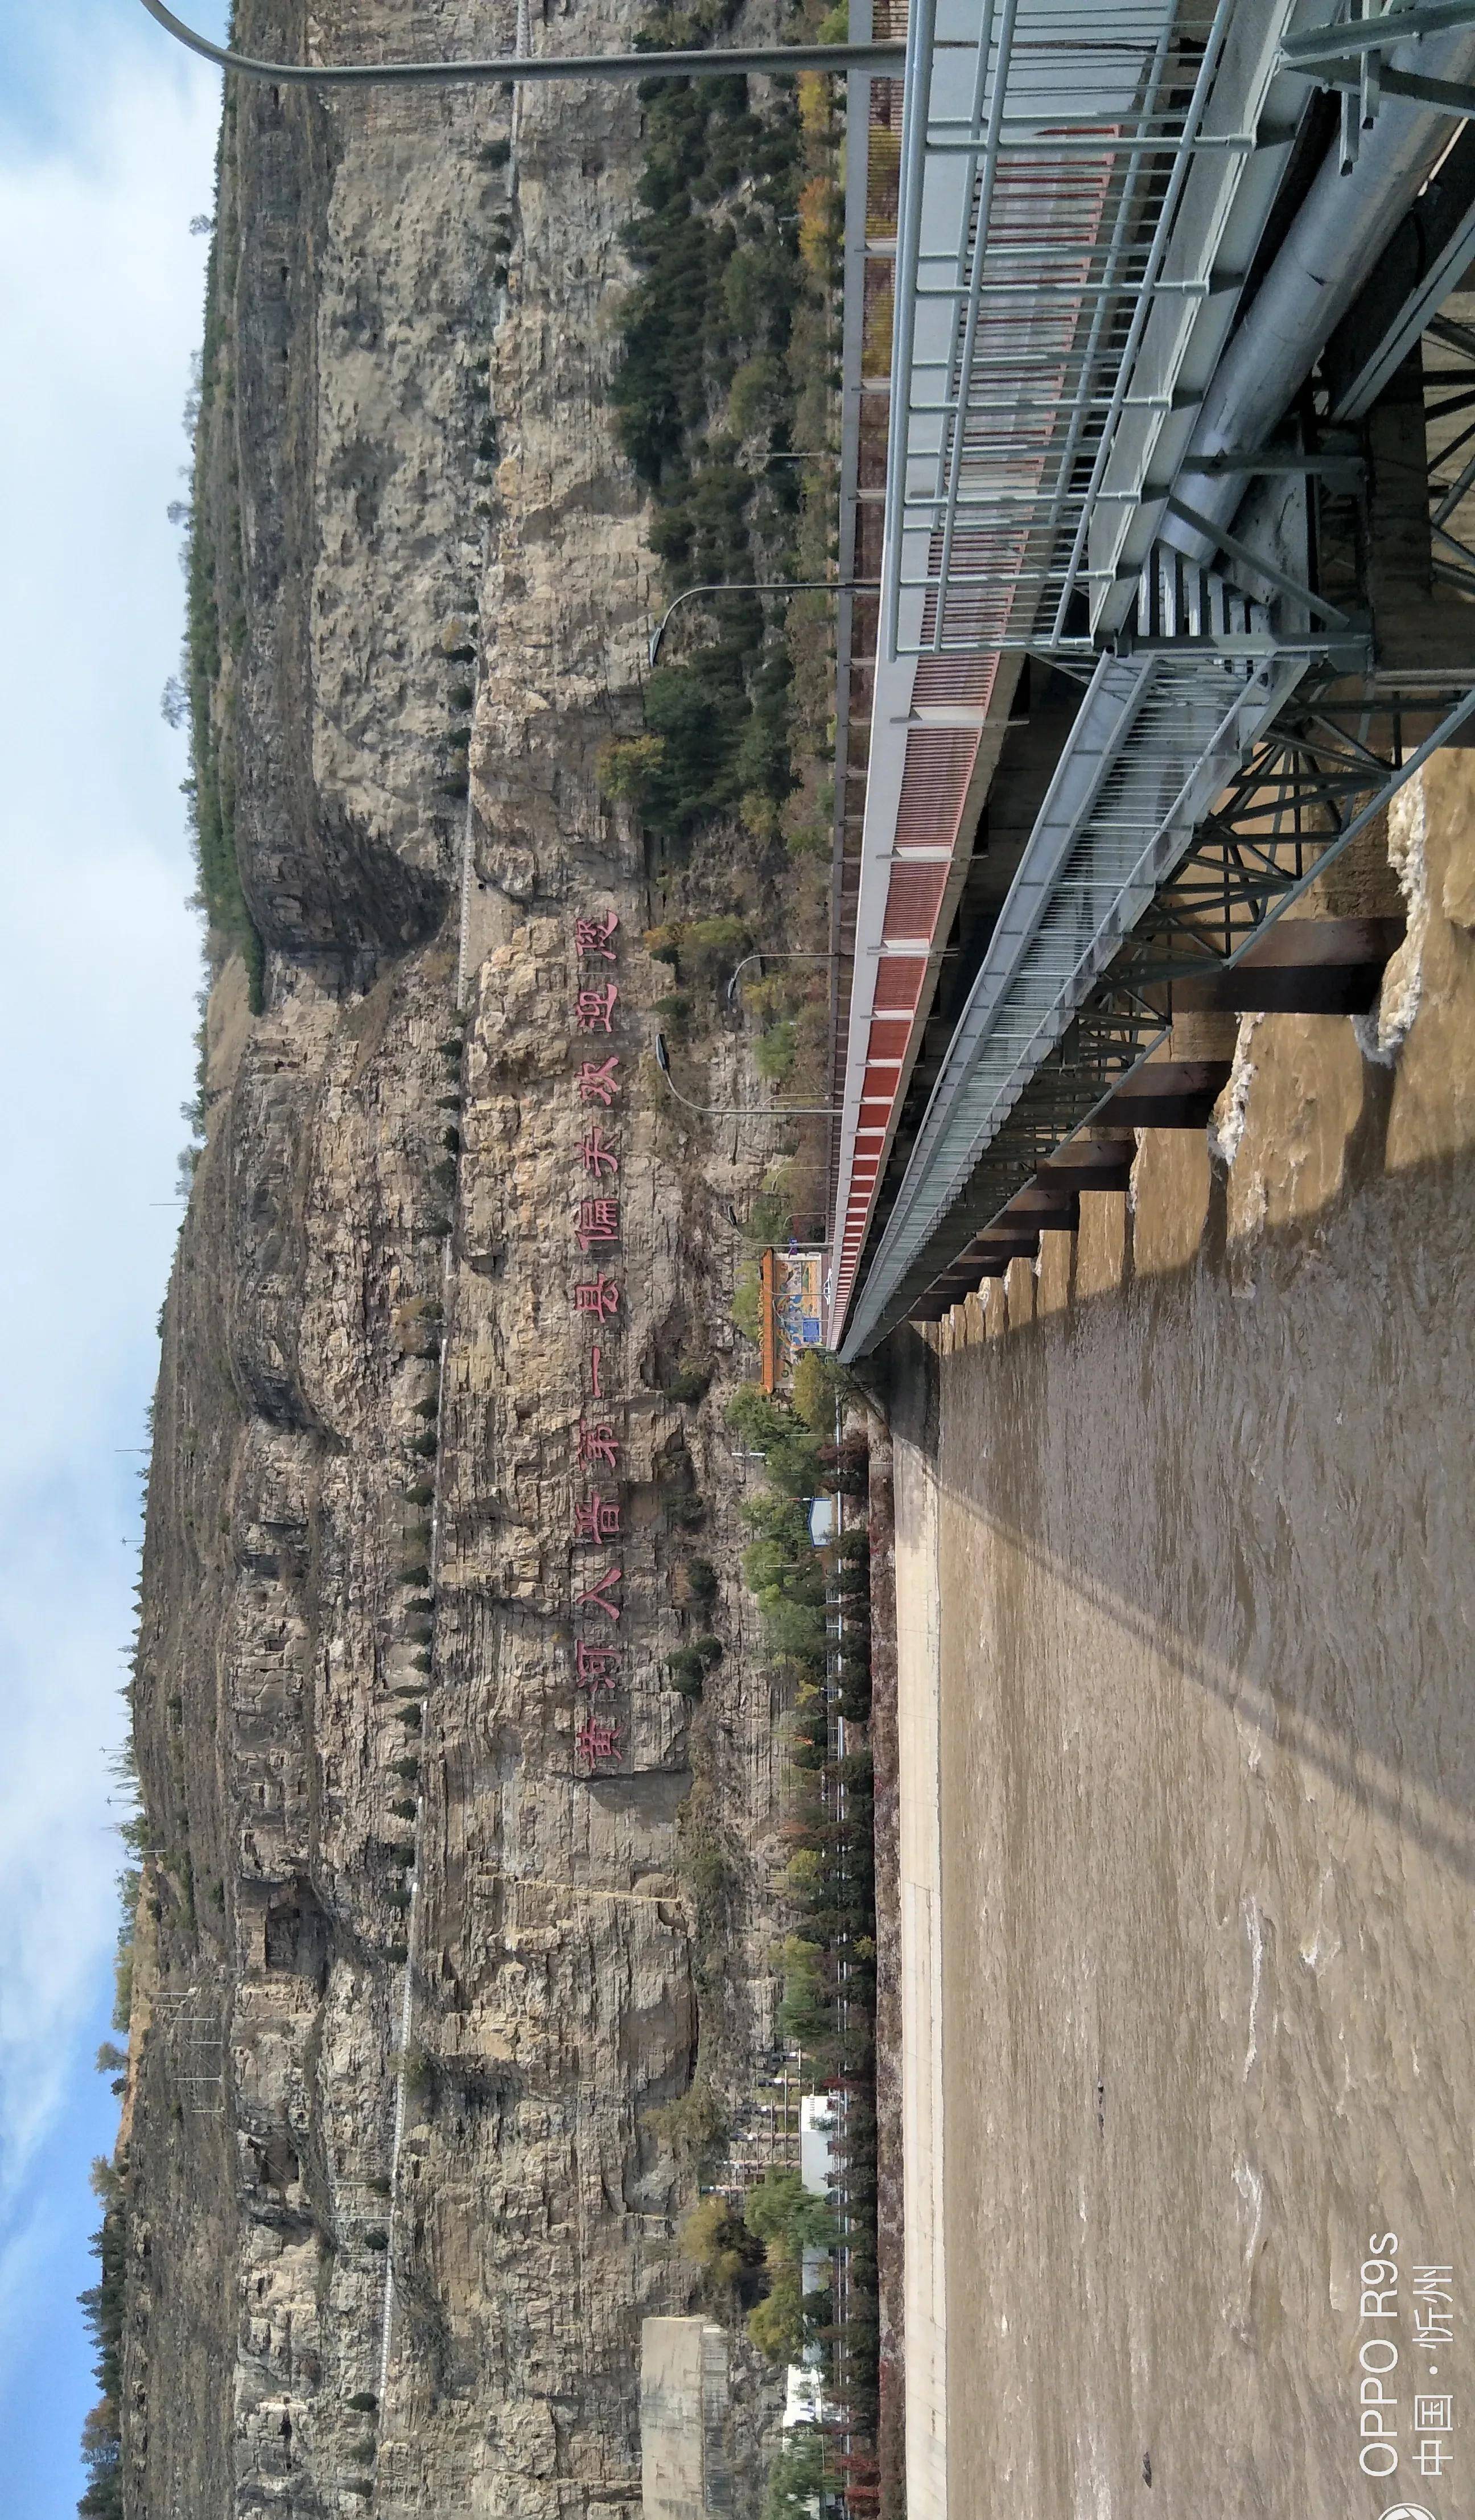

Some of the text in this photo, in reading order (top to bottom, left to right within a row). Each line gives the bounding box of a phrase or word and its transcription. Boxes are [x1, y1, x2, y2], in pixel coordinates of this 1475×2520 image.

[574, 910, 623, 1769] 黄河入晋第一县偏关欢迎您
